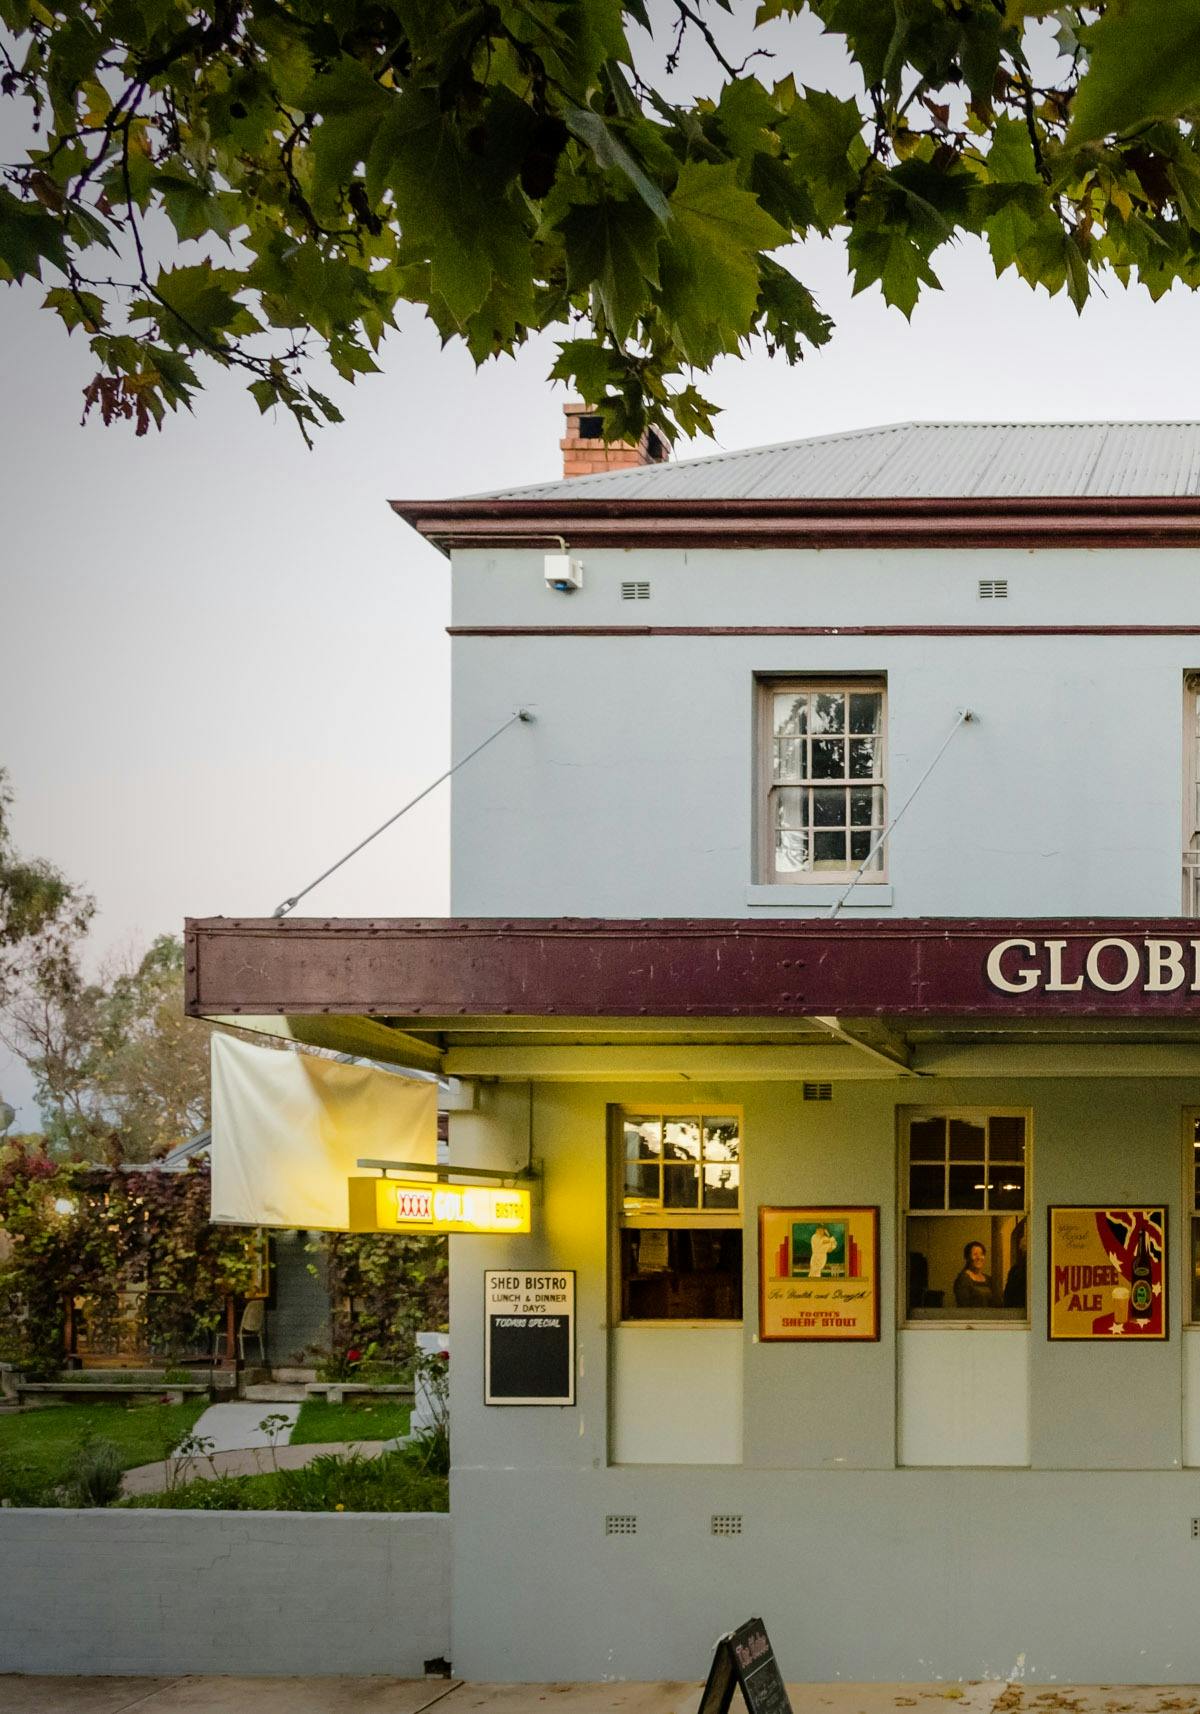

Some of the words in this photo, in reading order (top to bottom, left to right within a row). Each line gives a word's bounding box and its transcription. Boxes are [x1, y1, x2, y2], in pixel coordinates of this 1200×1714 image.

[399, 1193, 430, 1217] XXXX
[490, 1277, 520, 1290] SHED
[525, 1277, 567, 1290] BISTRO
[1055, 1265, 1120, 1305] MUDGEE
[492, 1294, 520, 1302] LUNCH
[535, 1294, 567, 1302] DINNER
[1067, 1295, 1102, 1312] ALE
[513, 1304, 519, 1312] 7
[528, 1318, 561, 1328] SPECIAL
[822, 1318, 857, 1327] STOUT
